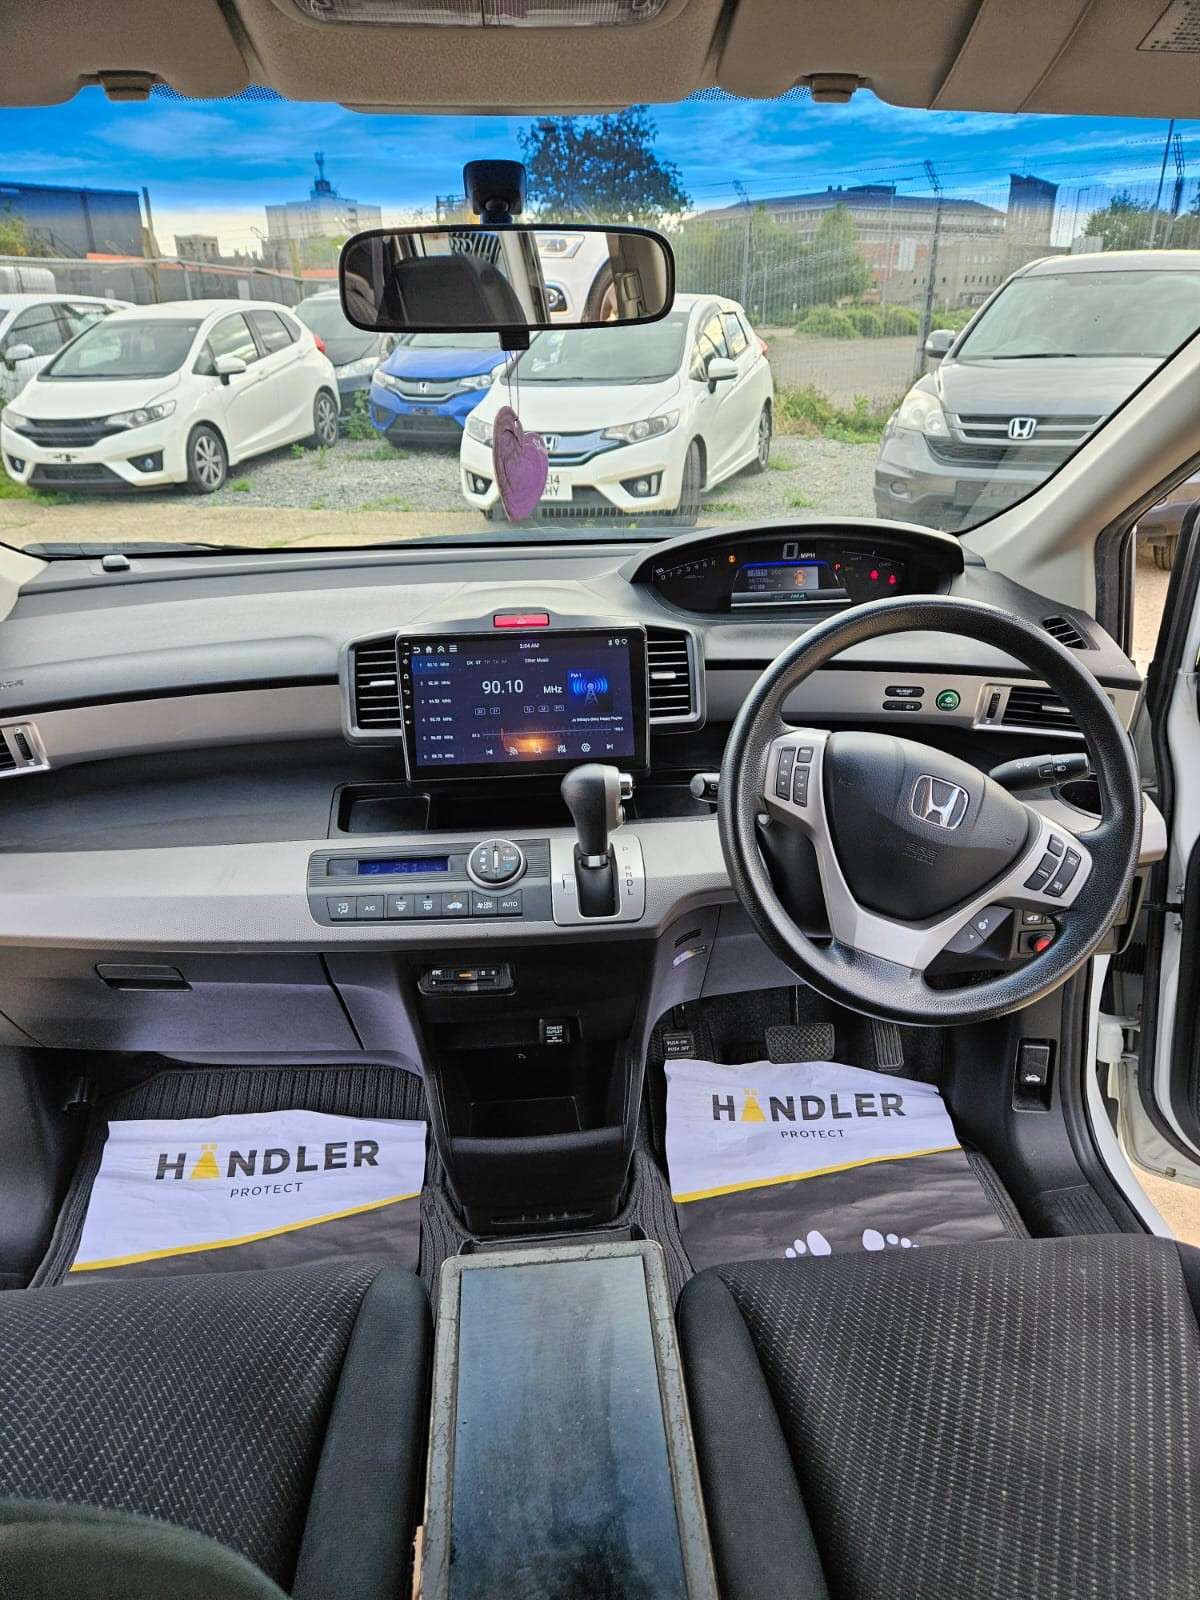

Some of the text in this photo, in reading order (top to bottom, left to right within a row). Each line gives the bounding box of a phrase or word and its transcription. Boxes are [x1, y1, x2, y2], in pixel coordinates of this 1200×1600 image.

[481, 679, 524, 694] 90.10
[543, 685, 563, 694] MHz
[780, 1128, 845, 1139] PROTECT
[229, 1181, 304, 1199] PROTECT
